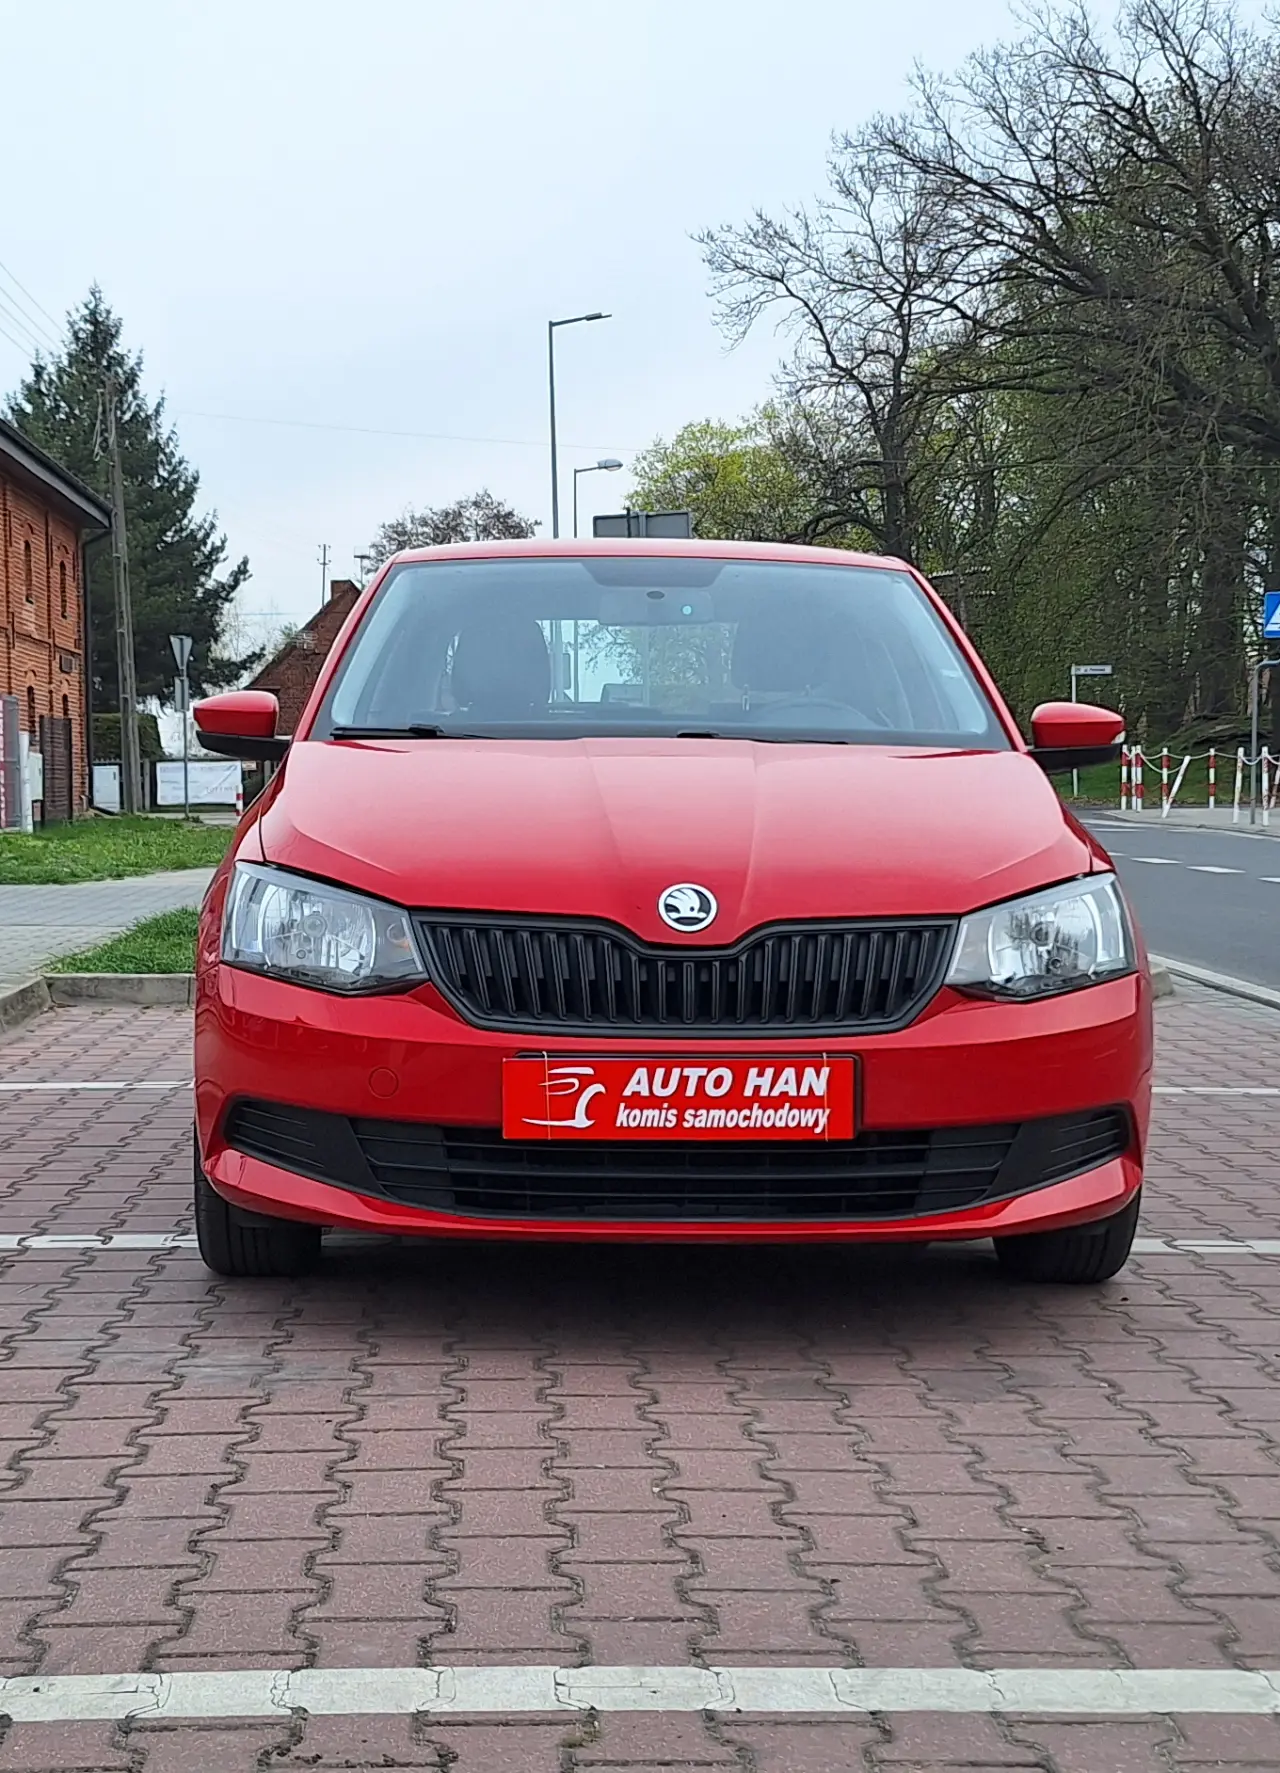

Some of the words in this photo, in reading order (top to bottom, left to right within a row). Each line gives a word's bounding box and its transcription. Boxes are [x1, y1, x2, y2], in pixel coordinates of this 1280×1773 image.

[622, 1067, 733, 1097] AUTO
[743, 1067, 830, 1097] HAN
[615, 1102, 678, 1128] komis
[682, 1102, 831, 1134] samochodowy
